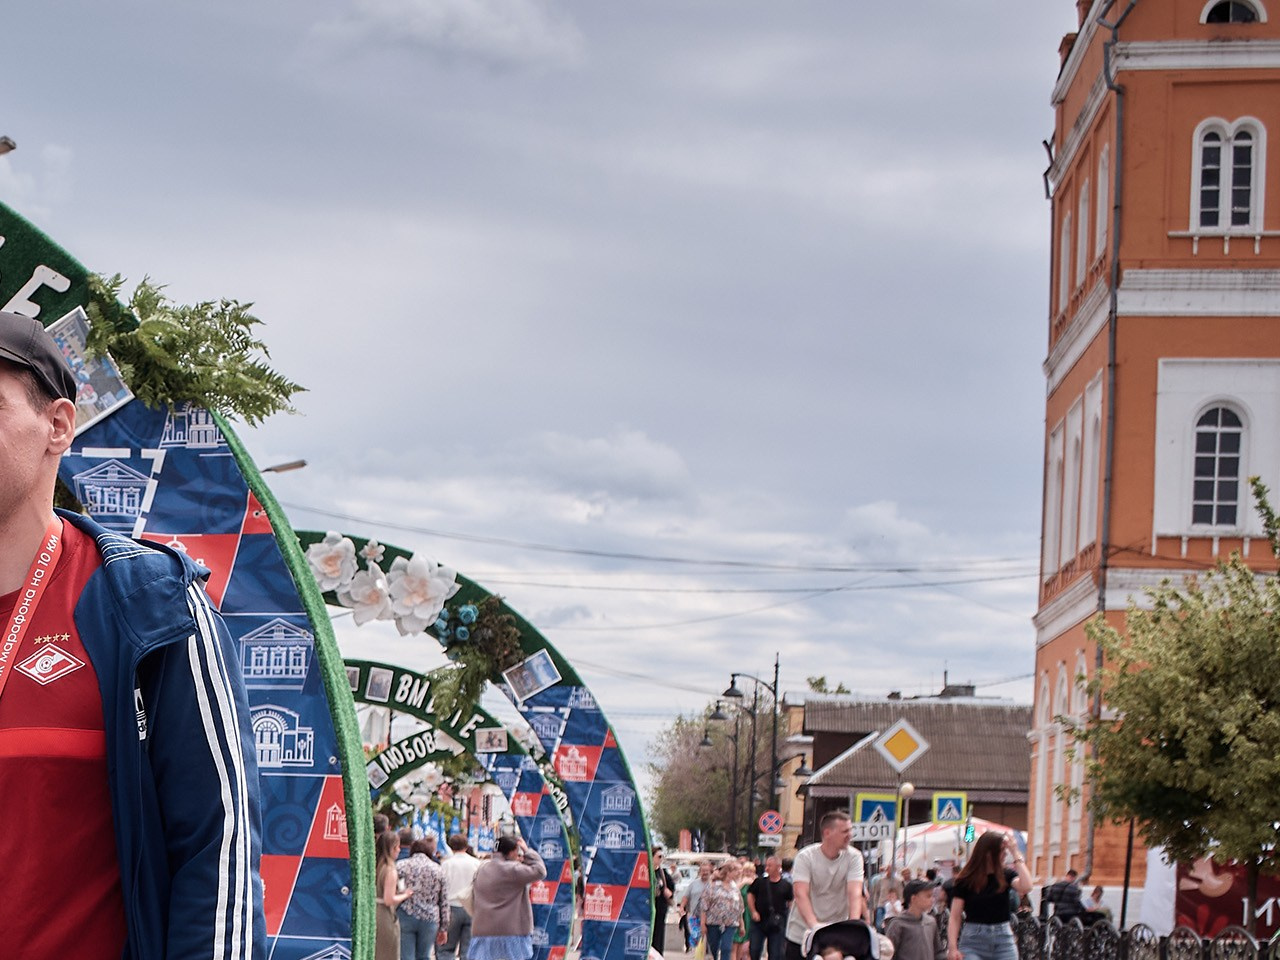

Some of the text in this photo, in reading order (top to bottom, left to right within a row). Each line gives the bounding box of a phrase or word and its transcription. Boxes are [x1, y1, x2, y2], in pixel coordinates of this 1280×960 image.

[37, 552, 51, 567] 10
[30, 569, 45, 588] на
[0, 589, 37, 663] марафона
[379, 731, 437, 774] ЛЮБОВ
